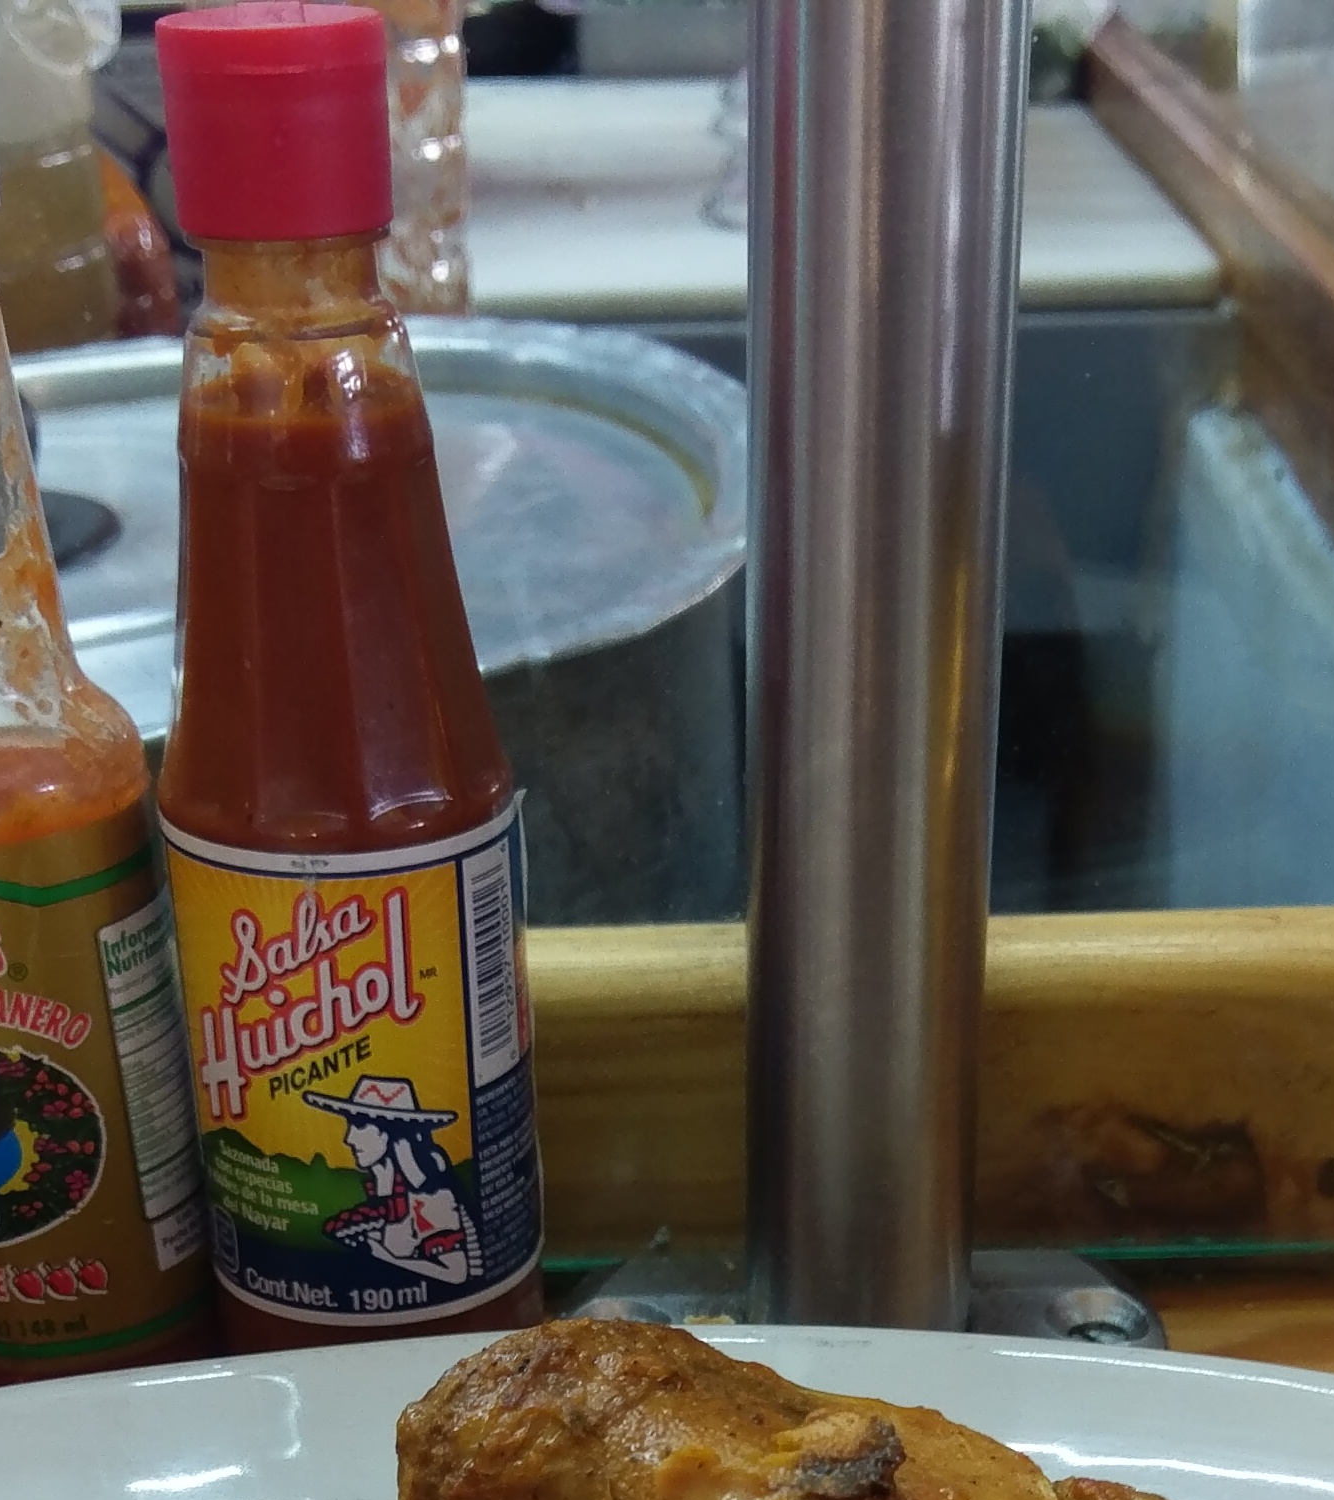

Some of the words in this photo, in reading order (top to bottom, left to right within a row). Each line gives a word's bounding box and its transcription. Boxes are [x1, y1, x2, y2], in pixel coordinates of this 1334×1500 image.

[222, 888, 371, 1005] Salsa
[419, 966, 438, 981] MR
[201, 892, 420, 1118] Huichol
[268, 1035, 373, 1100] PICANTE
[276, 1195, 319, 1216] mesa
[349, 1288, 394, 1311] 190
[398, 1280, 429, 1307] ml
